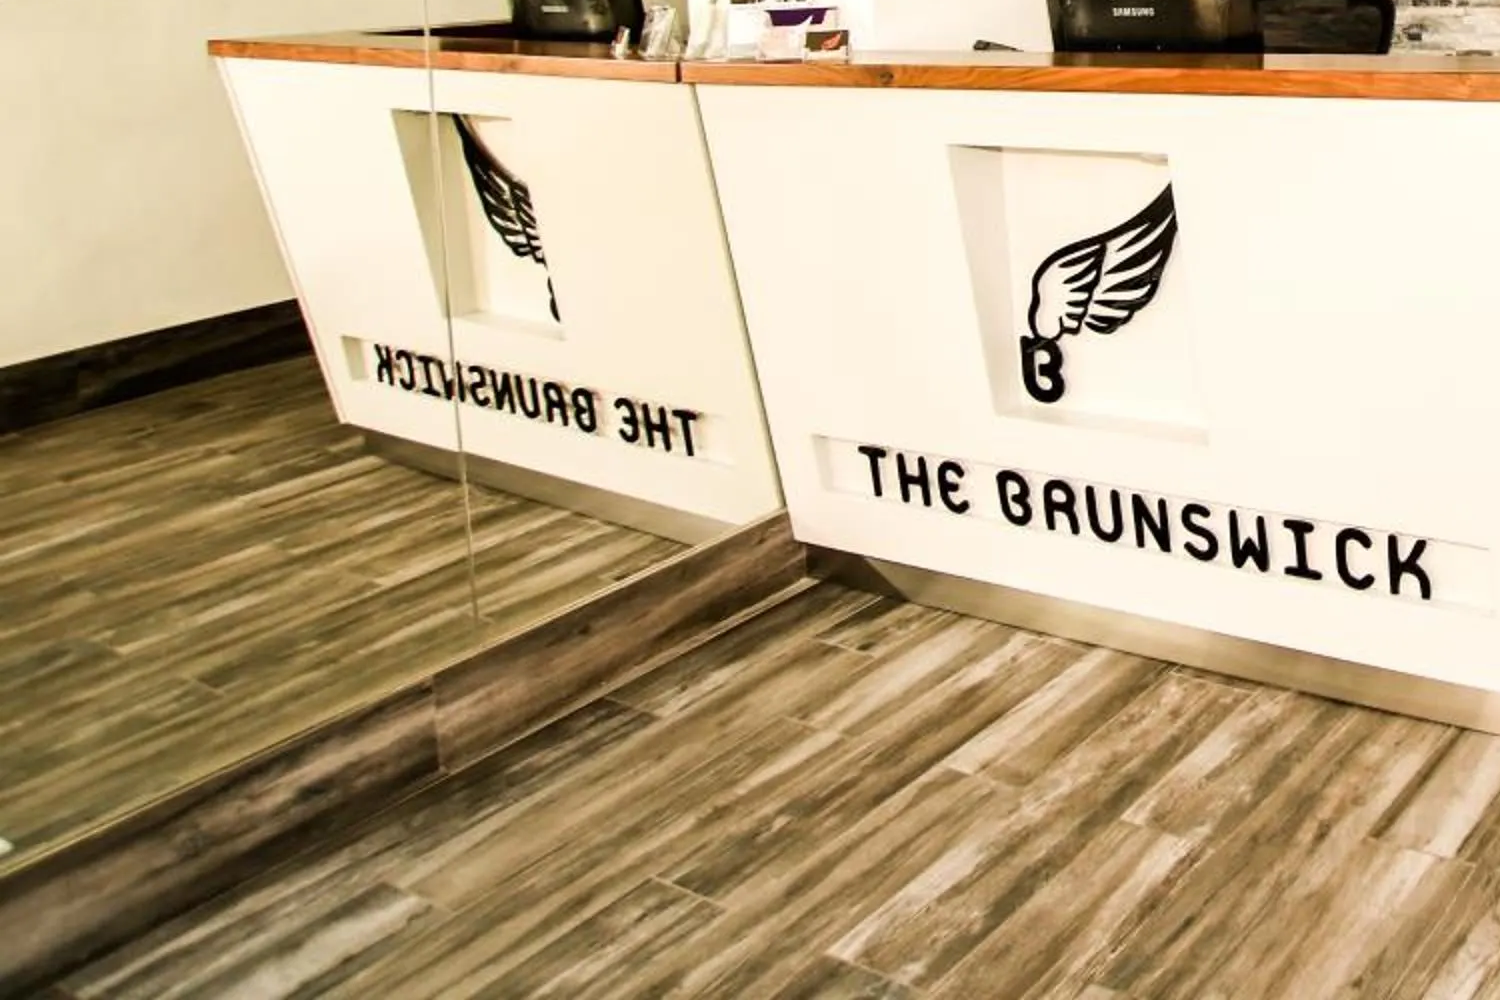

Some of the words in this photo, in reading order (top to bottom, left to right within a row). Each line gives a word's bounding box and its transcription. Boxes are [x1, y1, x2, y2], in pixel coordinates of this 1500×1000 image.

[1112, 6, 1156, 17] SAMSUNG
[1020, 334, 1066, 404] B
[857, 444, 971, 515] THE
[995, 468, 1433, 601] BRUNSWICK
